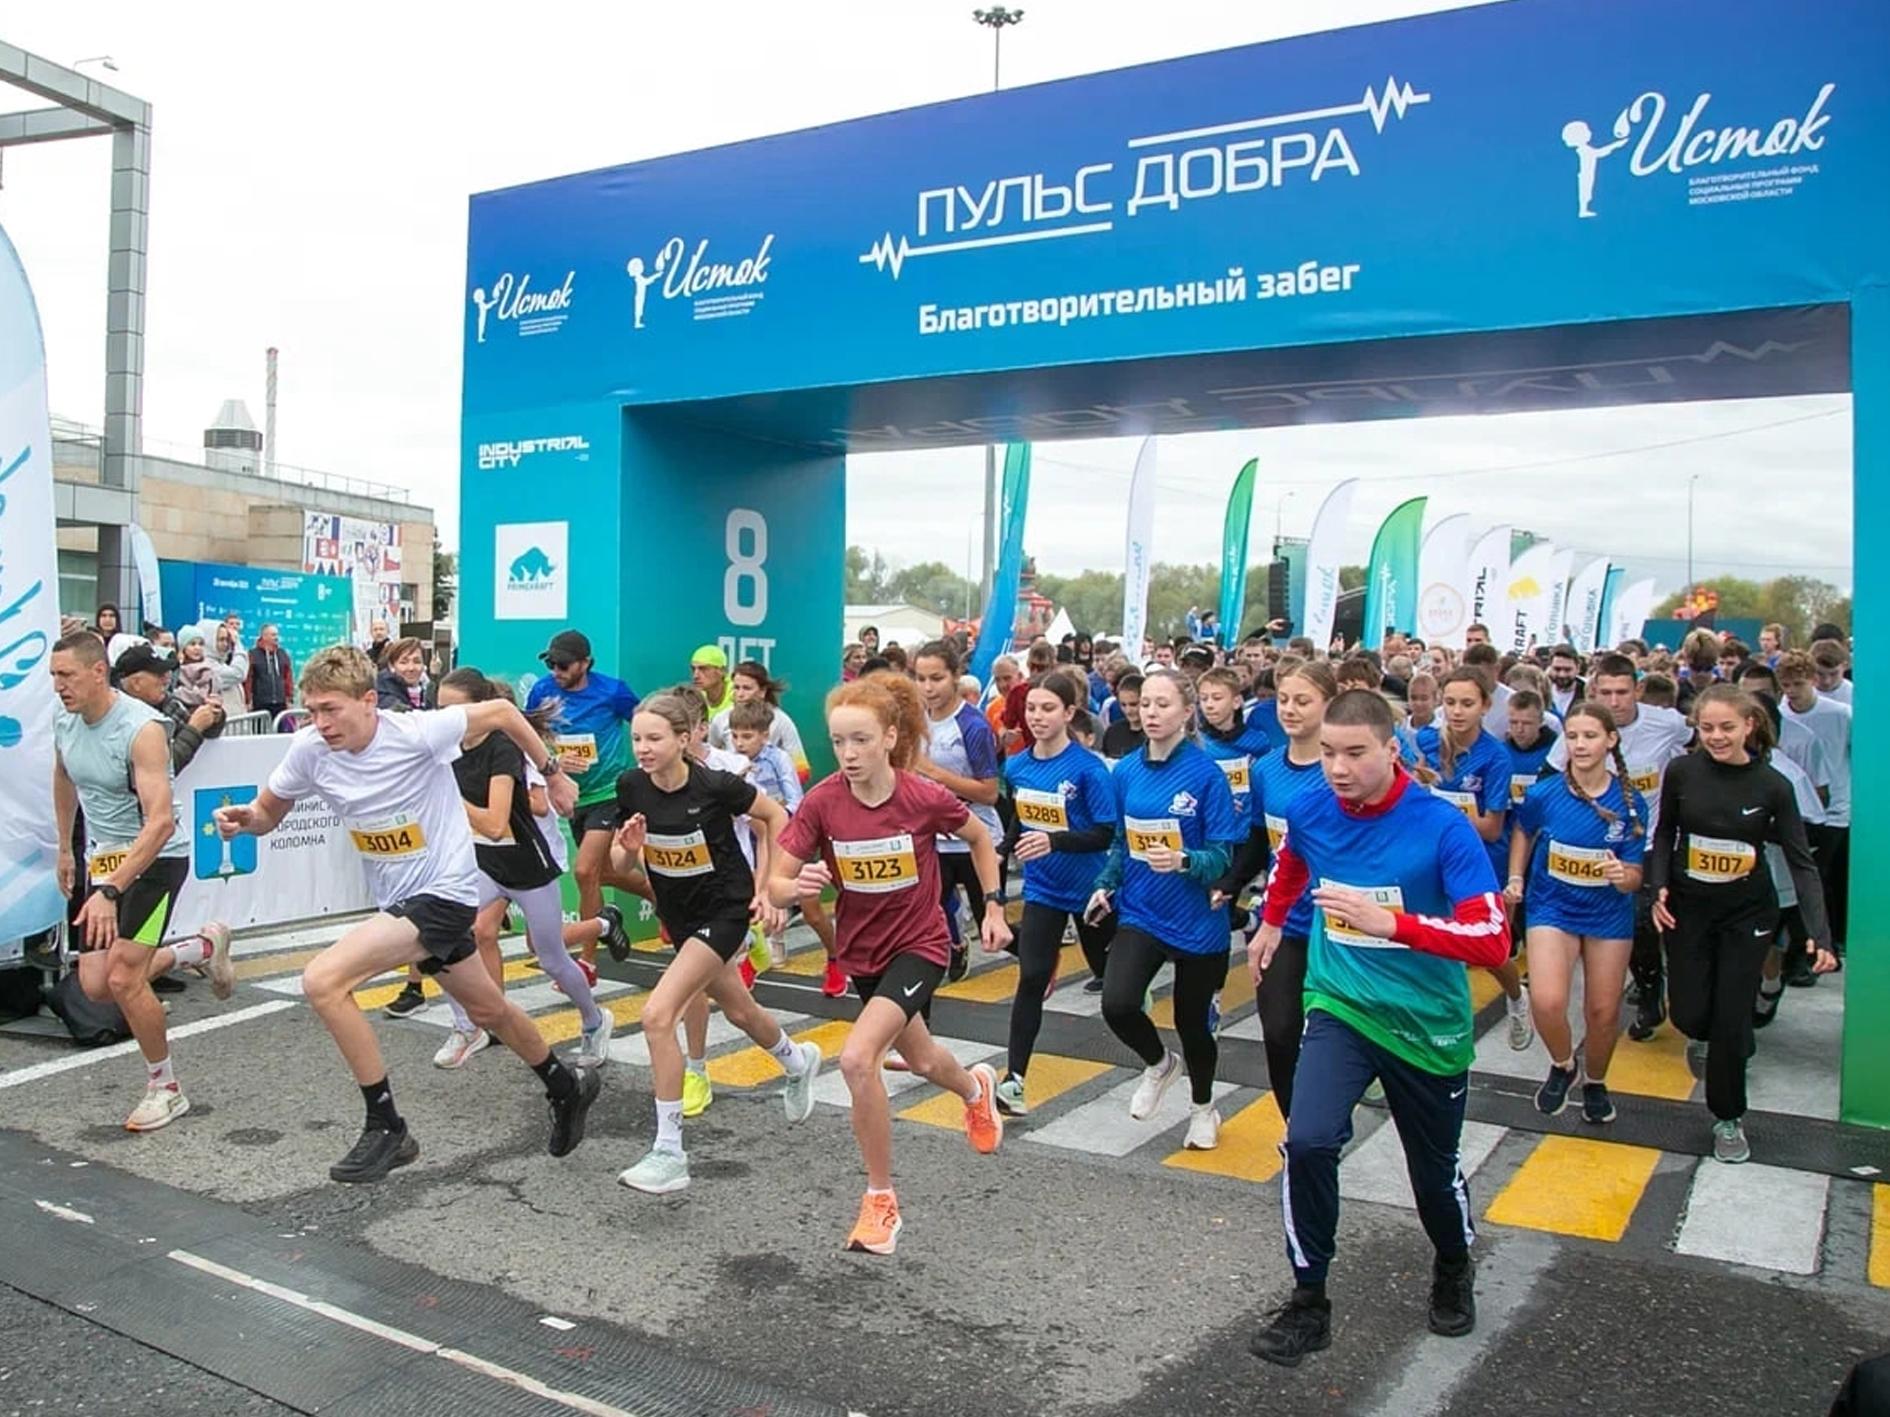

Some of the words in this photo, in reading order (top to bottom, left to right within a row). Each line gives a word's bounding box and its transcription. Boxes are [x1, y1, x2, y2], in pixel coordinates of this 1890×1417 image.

[1630, 83, 1835, 176] Исток
[918, 163, 1113, 236] ПУЛЬС
[1127, 128, 1360, 216] ДОБРА
[1689, 166, 1789, 185] БЛАГОТВОРИТЕЛЬНЫЙ
[662, 234, 775, 298] Исток
[497, 271, 576, 320] Исток
[919, 268, 1247, 334] Благотворительный
[1256, 260, 1360, 300] забег
[478, 435, 590, 457] INDUSTRIAL
[478, 453, 522, 469] CITY
[724, 508, 768, 627] 8
[1023, 804, 1060, 823] 3289
[270, 834, 326, 850] КОЛОМНА
[362, 830, 413, 852] 3014
[655, 850, 697, 867] 3124
[851, 858, 902, 880] 3123
[1698, 852, 1742, 873] 3107
